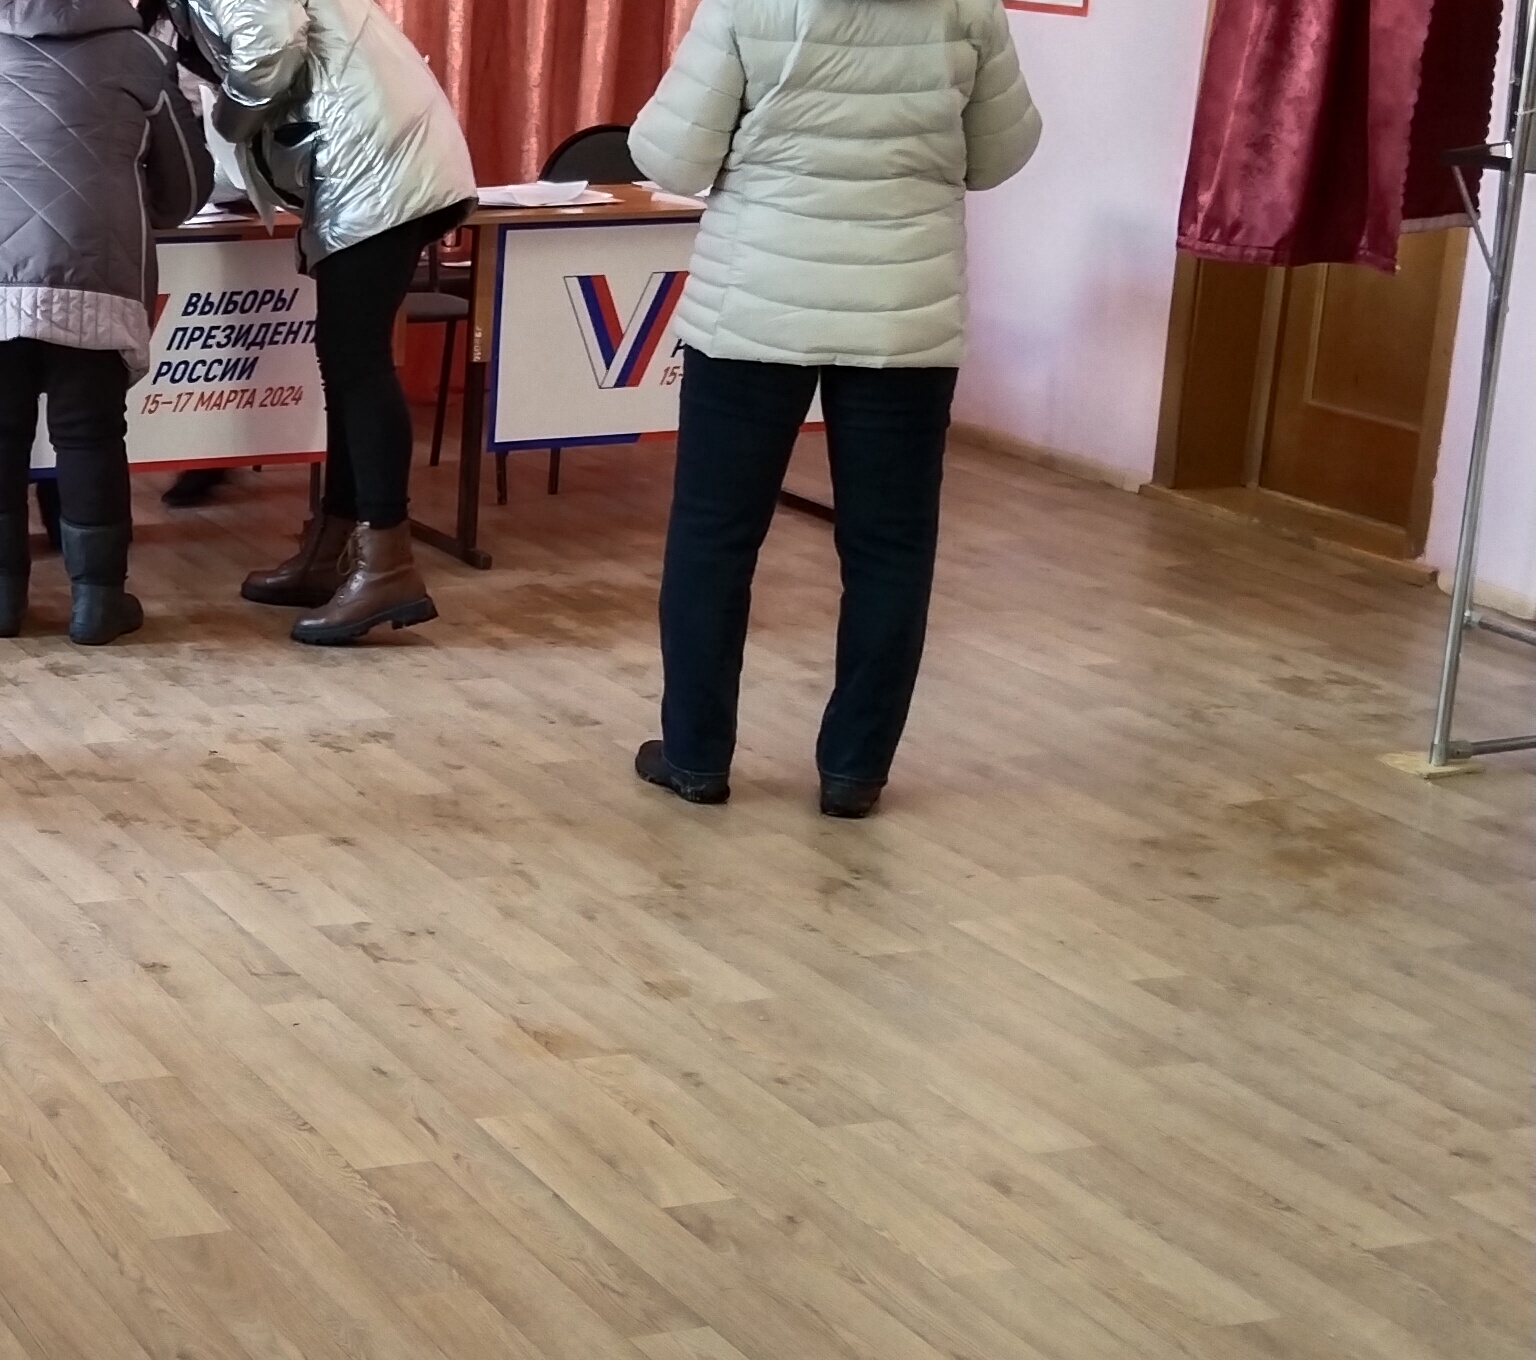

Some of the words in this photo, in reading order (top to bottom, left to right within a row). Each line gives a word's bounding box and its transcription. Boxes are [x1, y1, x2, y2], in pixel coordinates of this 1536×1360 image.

[181, 288, 299, 317] ВЫБОРЫ
[151, 356, 260, 385] РОССИИ
[193, 389, 257, 412] МАРТА
[258, 386, 303, 408] 2024
